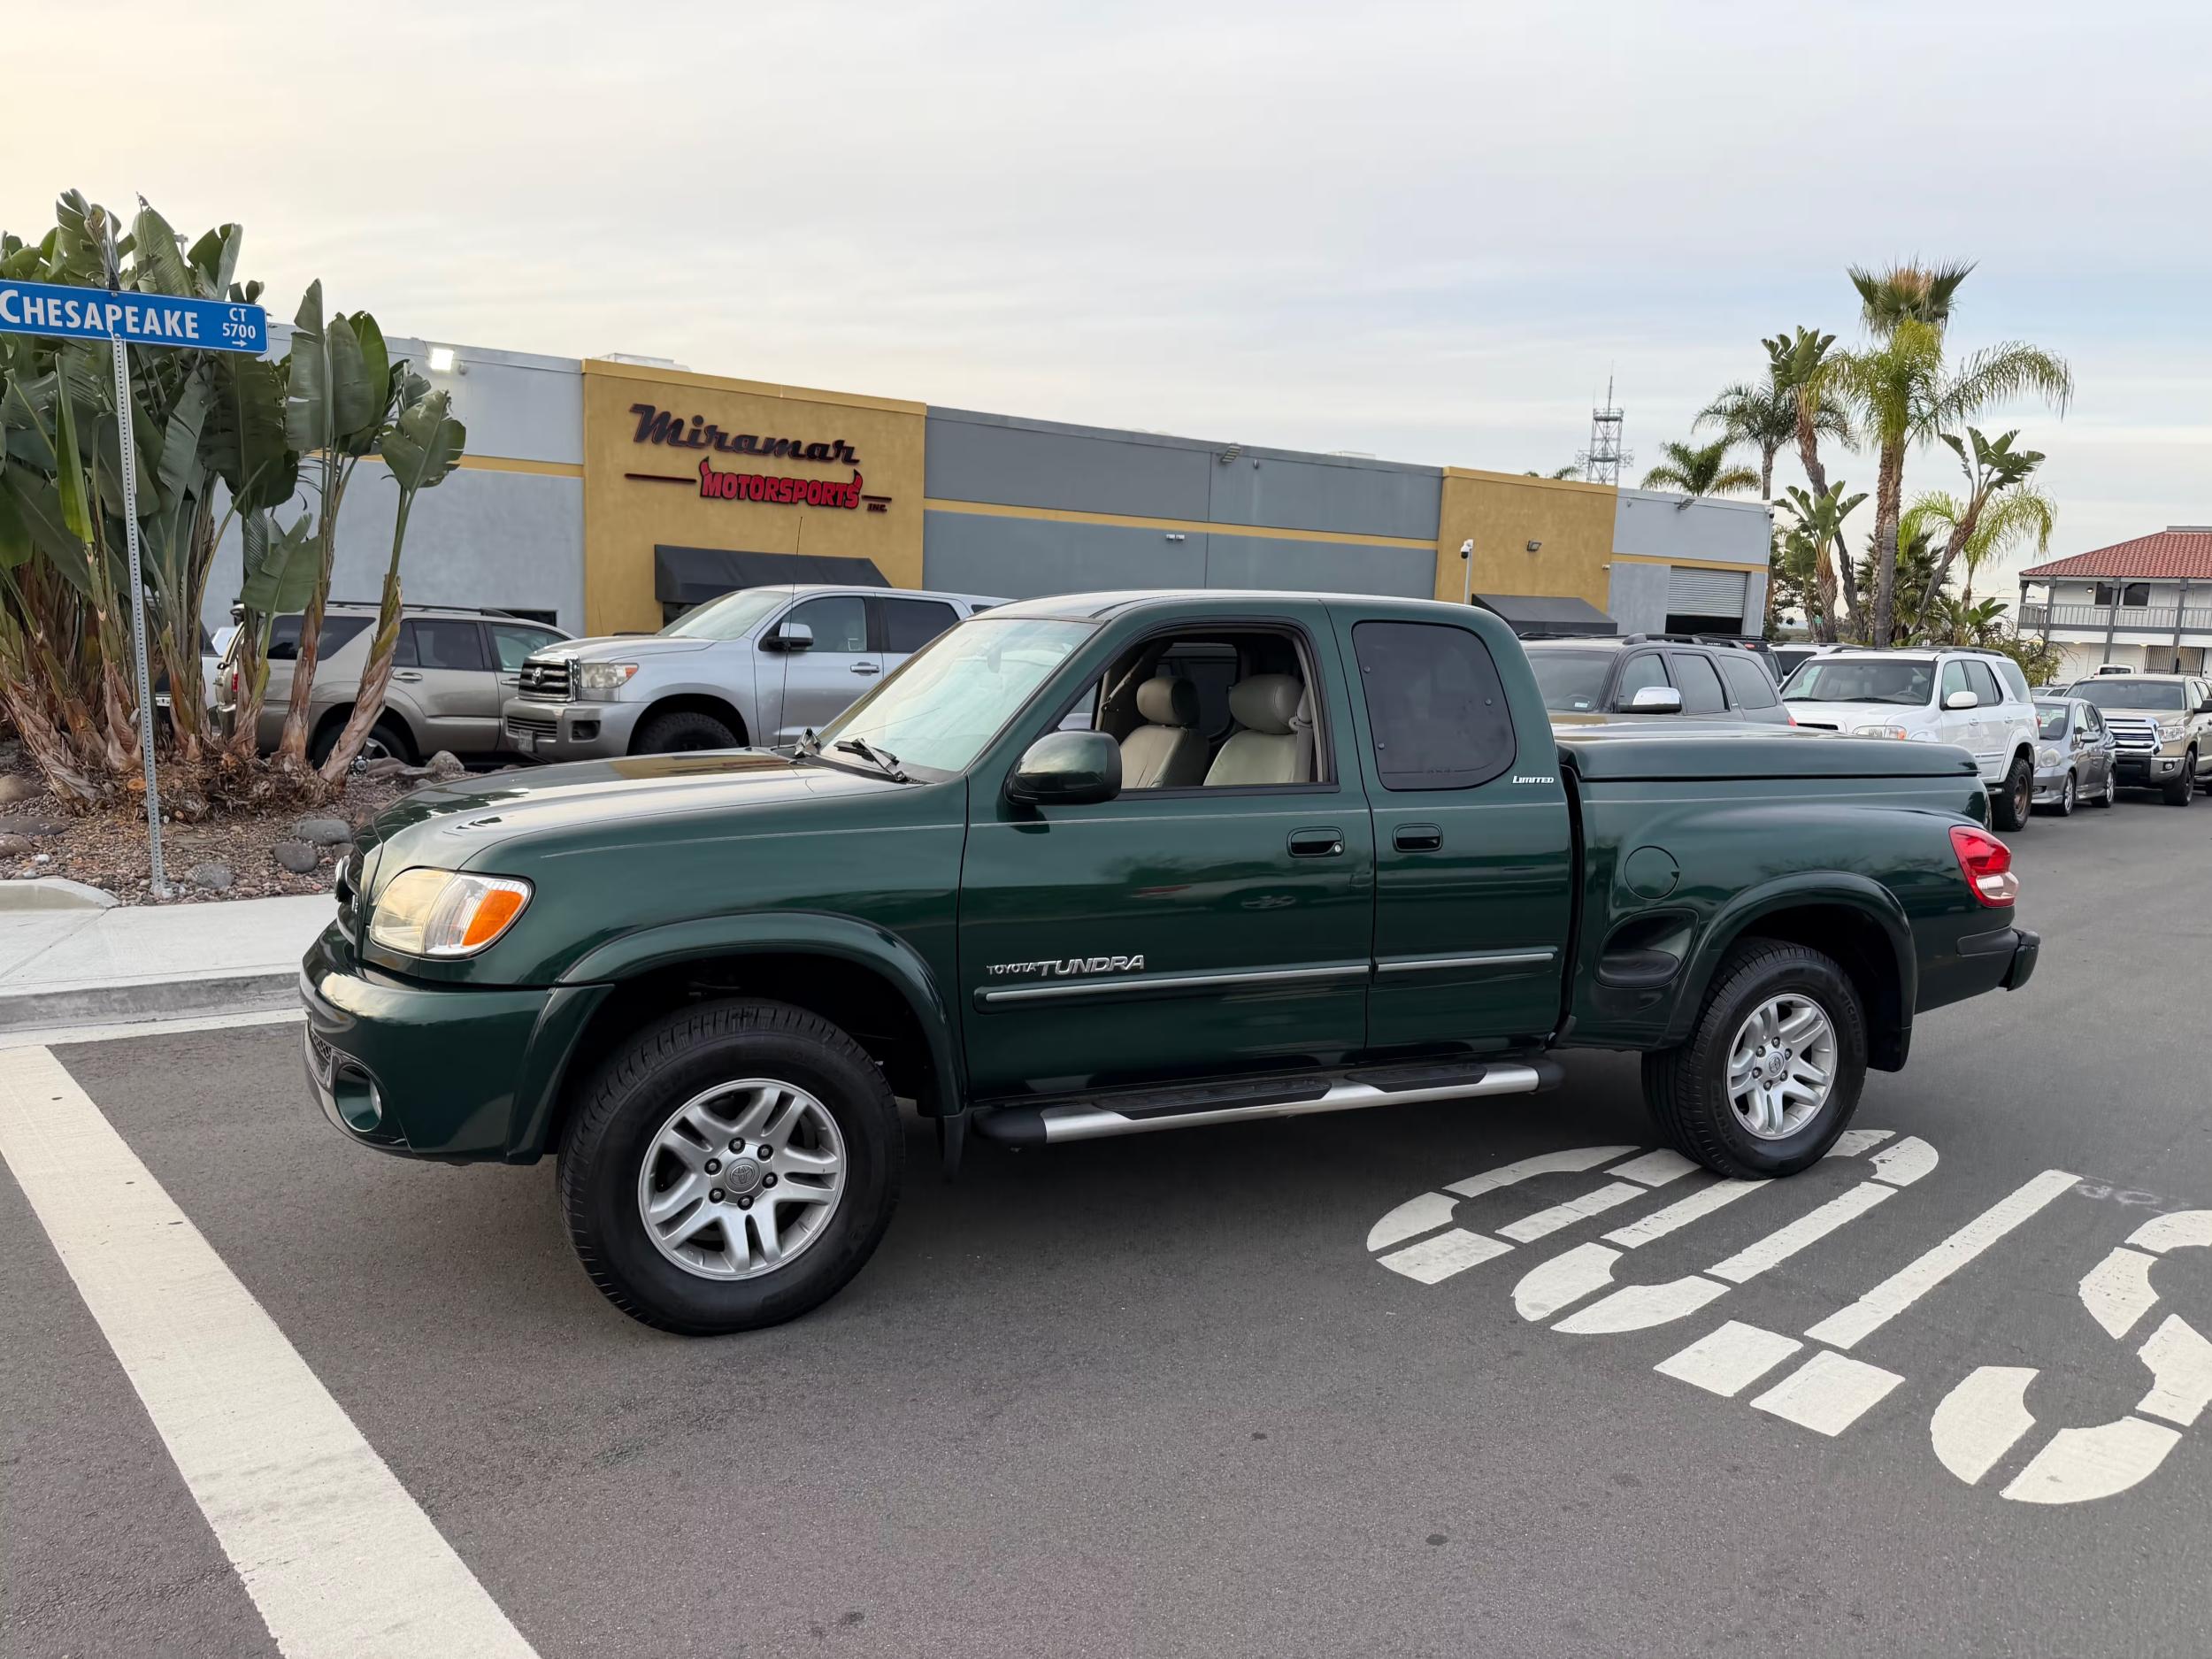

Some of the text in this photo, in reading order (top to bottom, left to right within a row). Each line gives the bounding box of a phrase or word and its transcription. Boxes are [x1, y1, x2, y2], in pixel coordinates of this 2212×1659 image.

[0, 289, 200, 340] CHESAPEAKE
[228, 307, 247, 323] CT
[221, 323, 257, 340] 5700
[629, 403, 861, 465] Miramar
[699, 470, 864, 510] MOTORSPORTS
[987, 955, 1145, 977] TOYOTA TUNDRA
